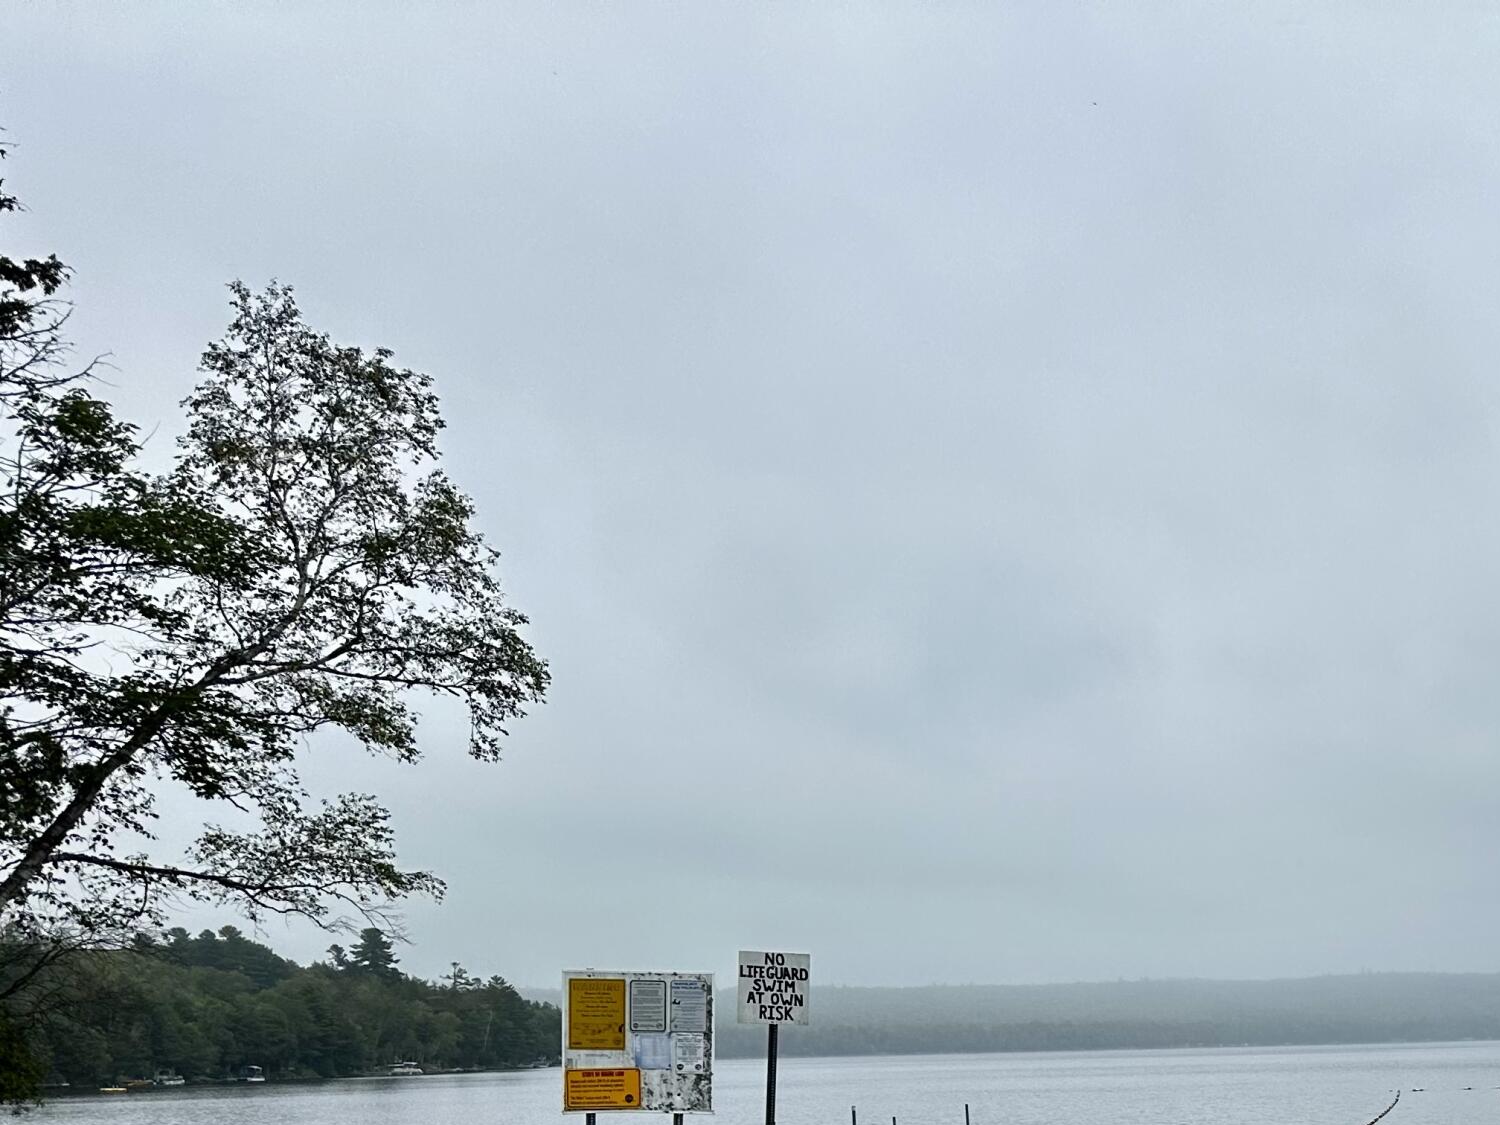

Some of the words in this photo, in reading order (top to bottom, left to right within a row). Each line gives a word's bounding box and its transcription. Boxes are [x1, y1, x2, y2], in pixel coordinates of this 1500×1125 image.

[765, 952, 785, 966] NO
[740, 965, 809, 981] LIFEGUARD
[752, 979, 796, 993] SWIM
[746, 991, 765, 1004] AT
[770, 993, 804, 1007] OWN
[759, 1004, 794, 1021] RISK
